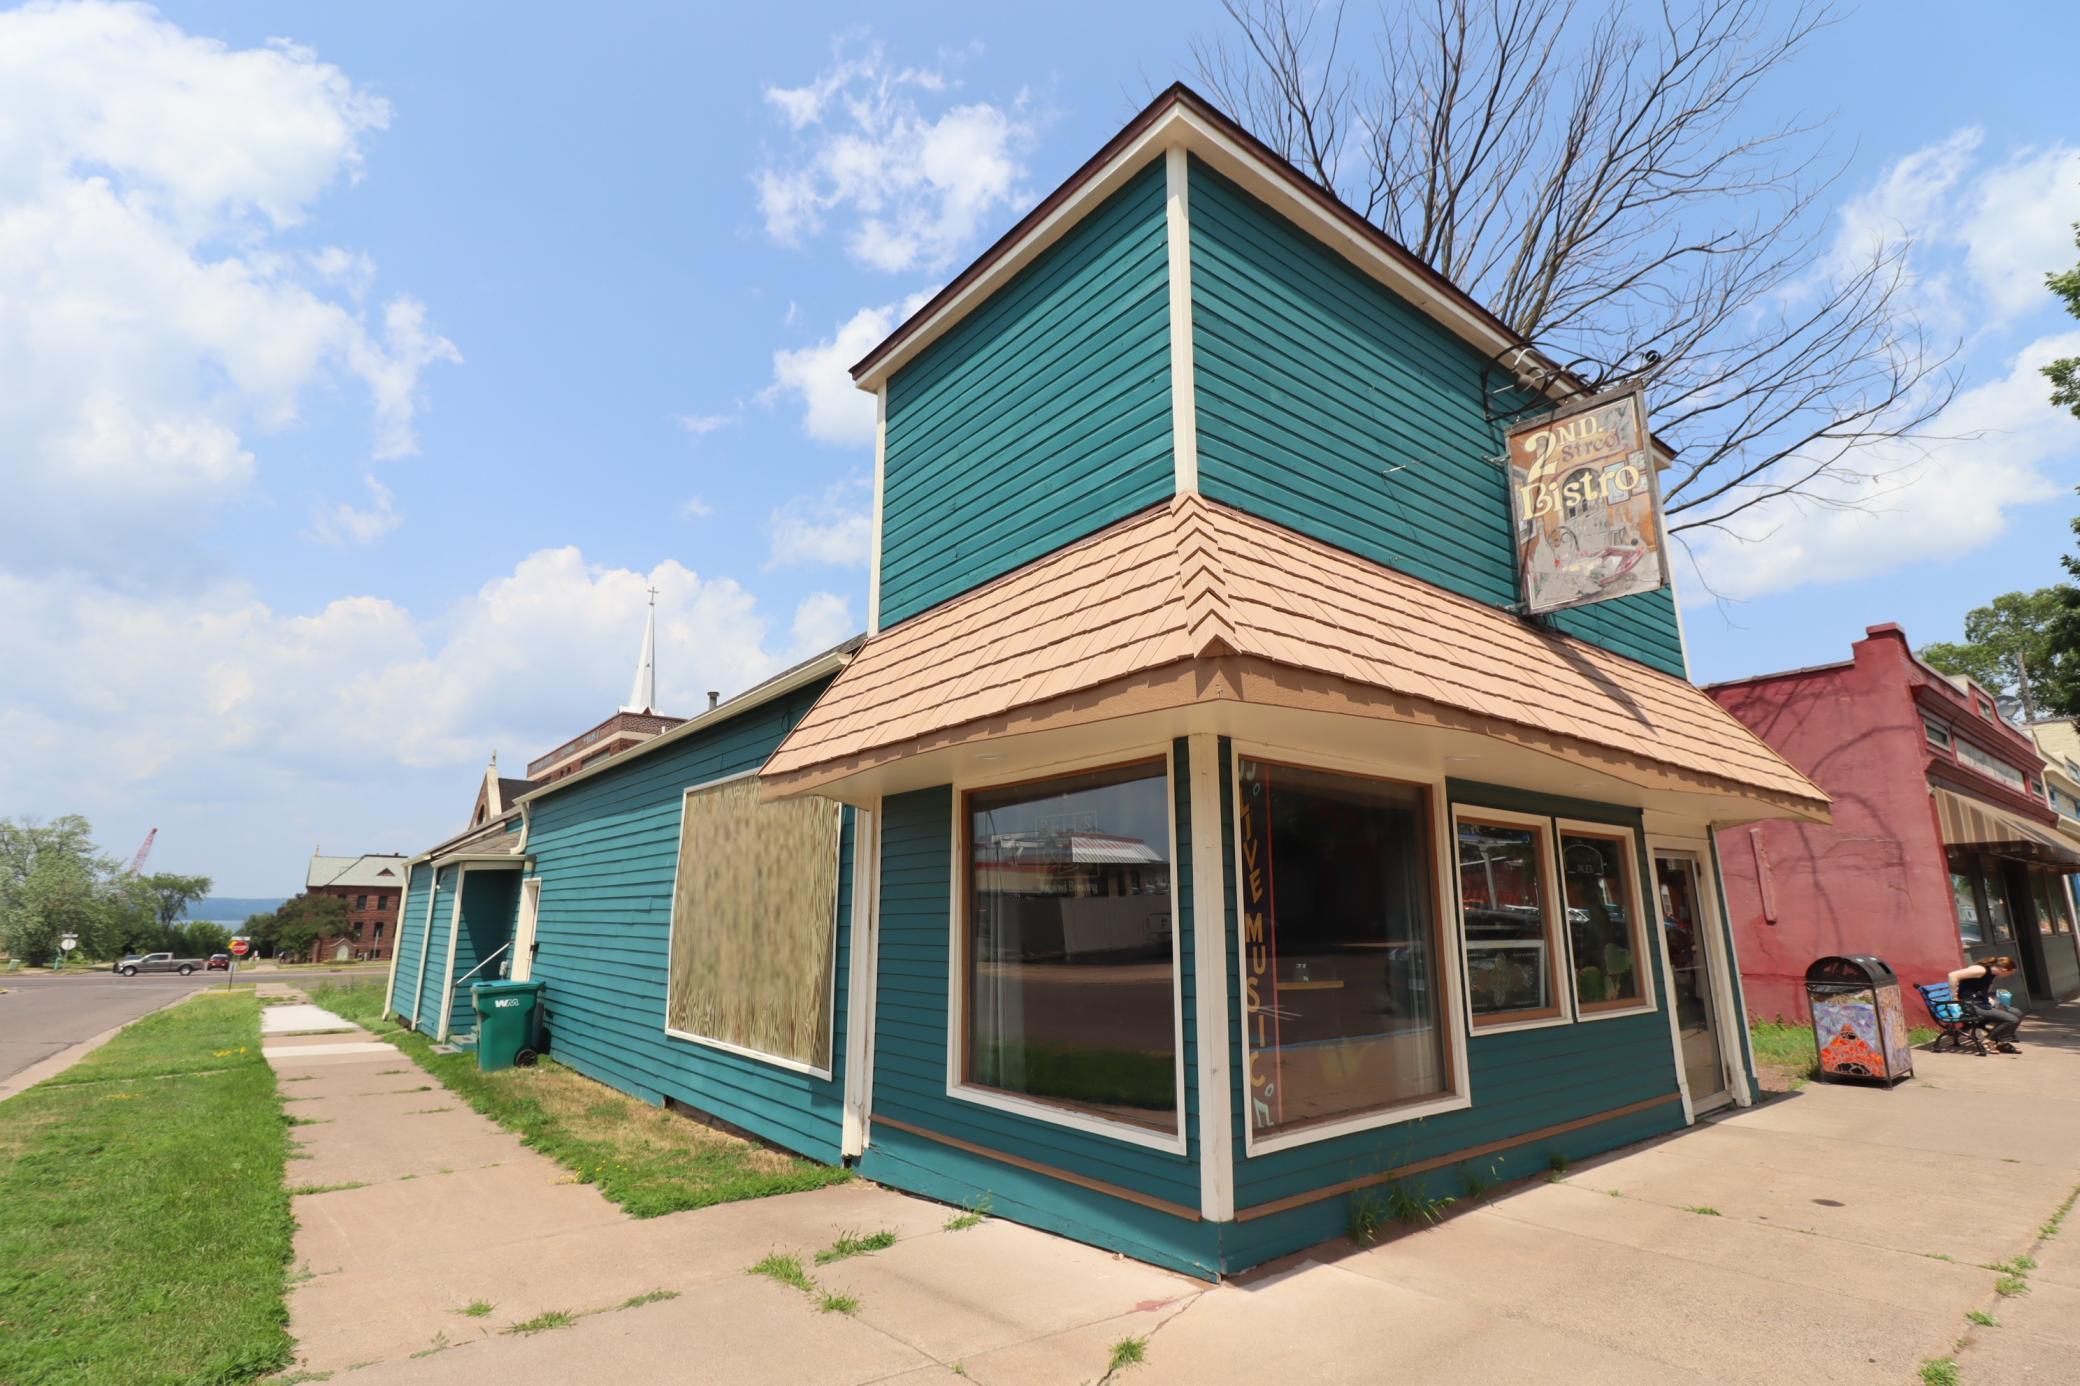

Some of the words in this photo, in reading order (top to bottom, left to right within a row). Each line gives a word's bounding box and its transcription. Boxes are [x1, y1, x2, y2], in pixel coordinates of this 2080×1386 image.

[1561, 430, 1621, 463] Street
[1519, 464, 1640, 521] Bistro
[1239, 784, 1263, 904] LIVE
[494, 998, 519, 1008] WM
[1244, 912, 1267, 1088] MUSIC
